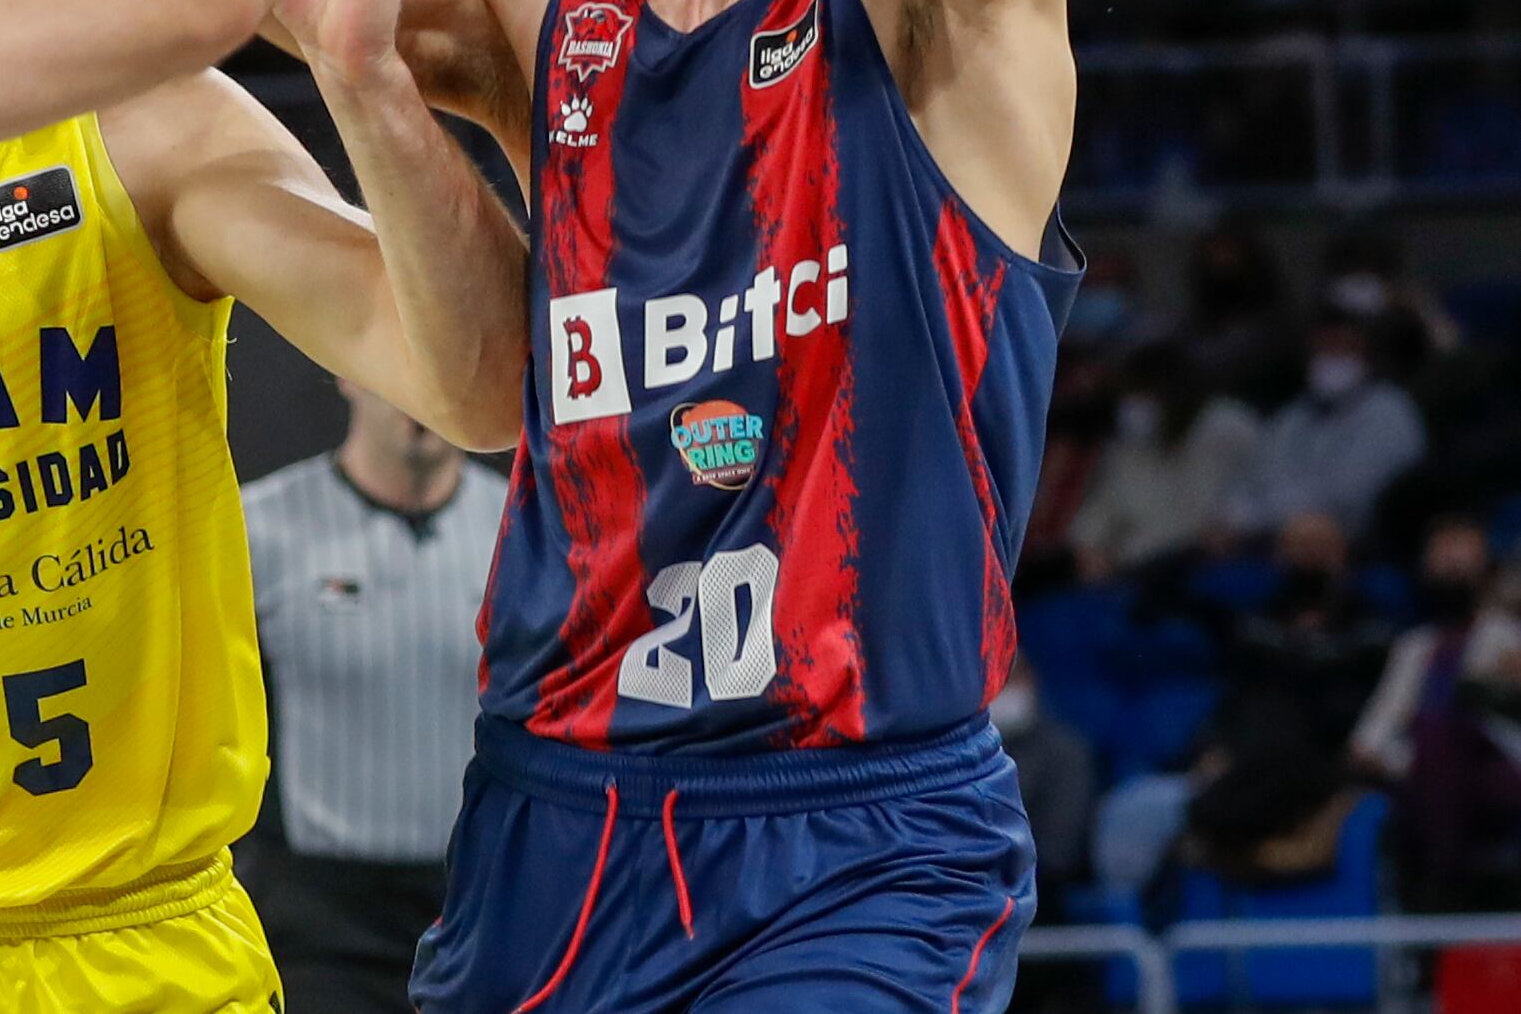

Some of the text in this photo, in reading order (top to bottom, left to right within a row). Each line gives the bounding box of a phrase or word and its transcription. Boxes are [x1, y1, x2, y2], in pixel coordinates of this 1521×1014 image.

[760, 41, 794, 66] liga
[549, 130, 598, 147] KELME
[644, 243, 849, 389] Bitci
[670, 414, 765, 449] OUTER
[686, 439, 756, 470] RING
[31, 526, 155, 594] Cálida
[21, 596, 93, 628] Murcia
[617, 543, 779, 710] 20
